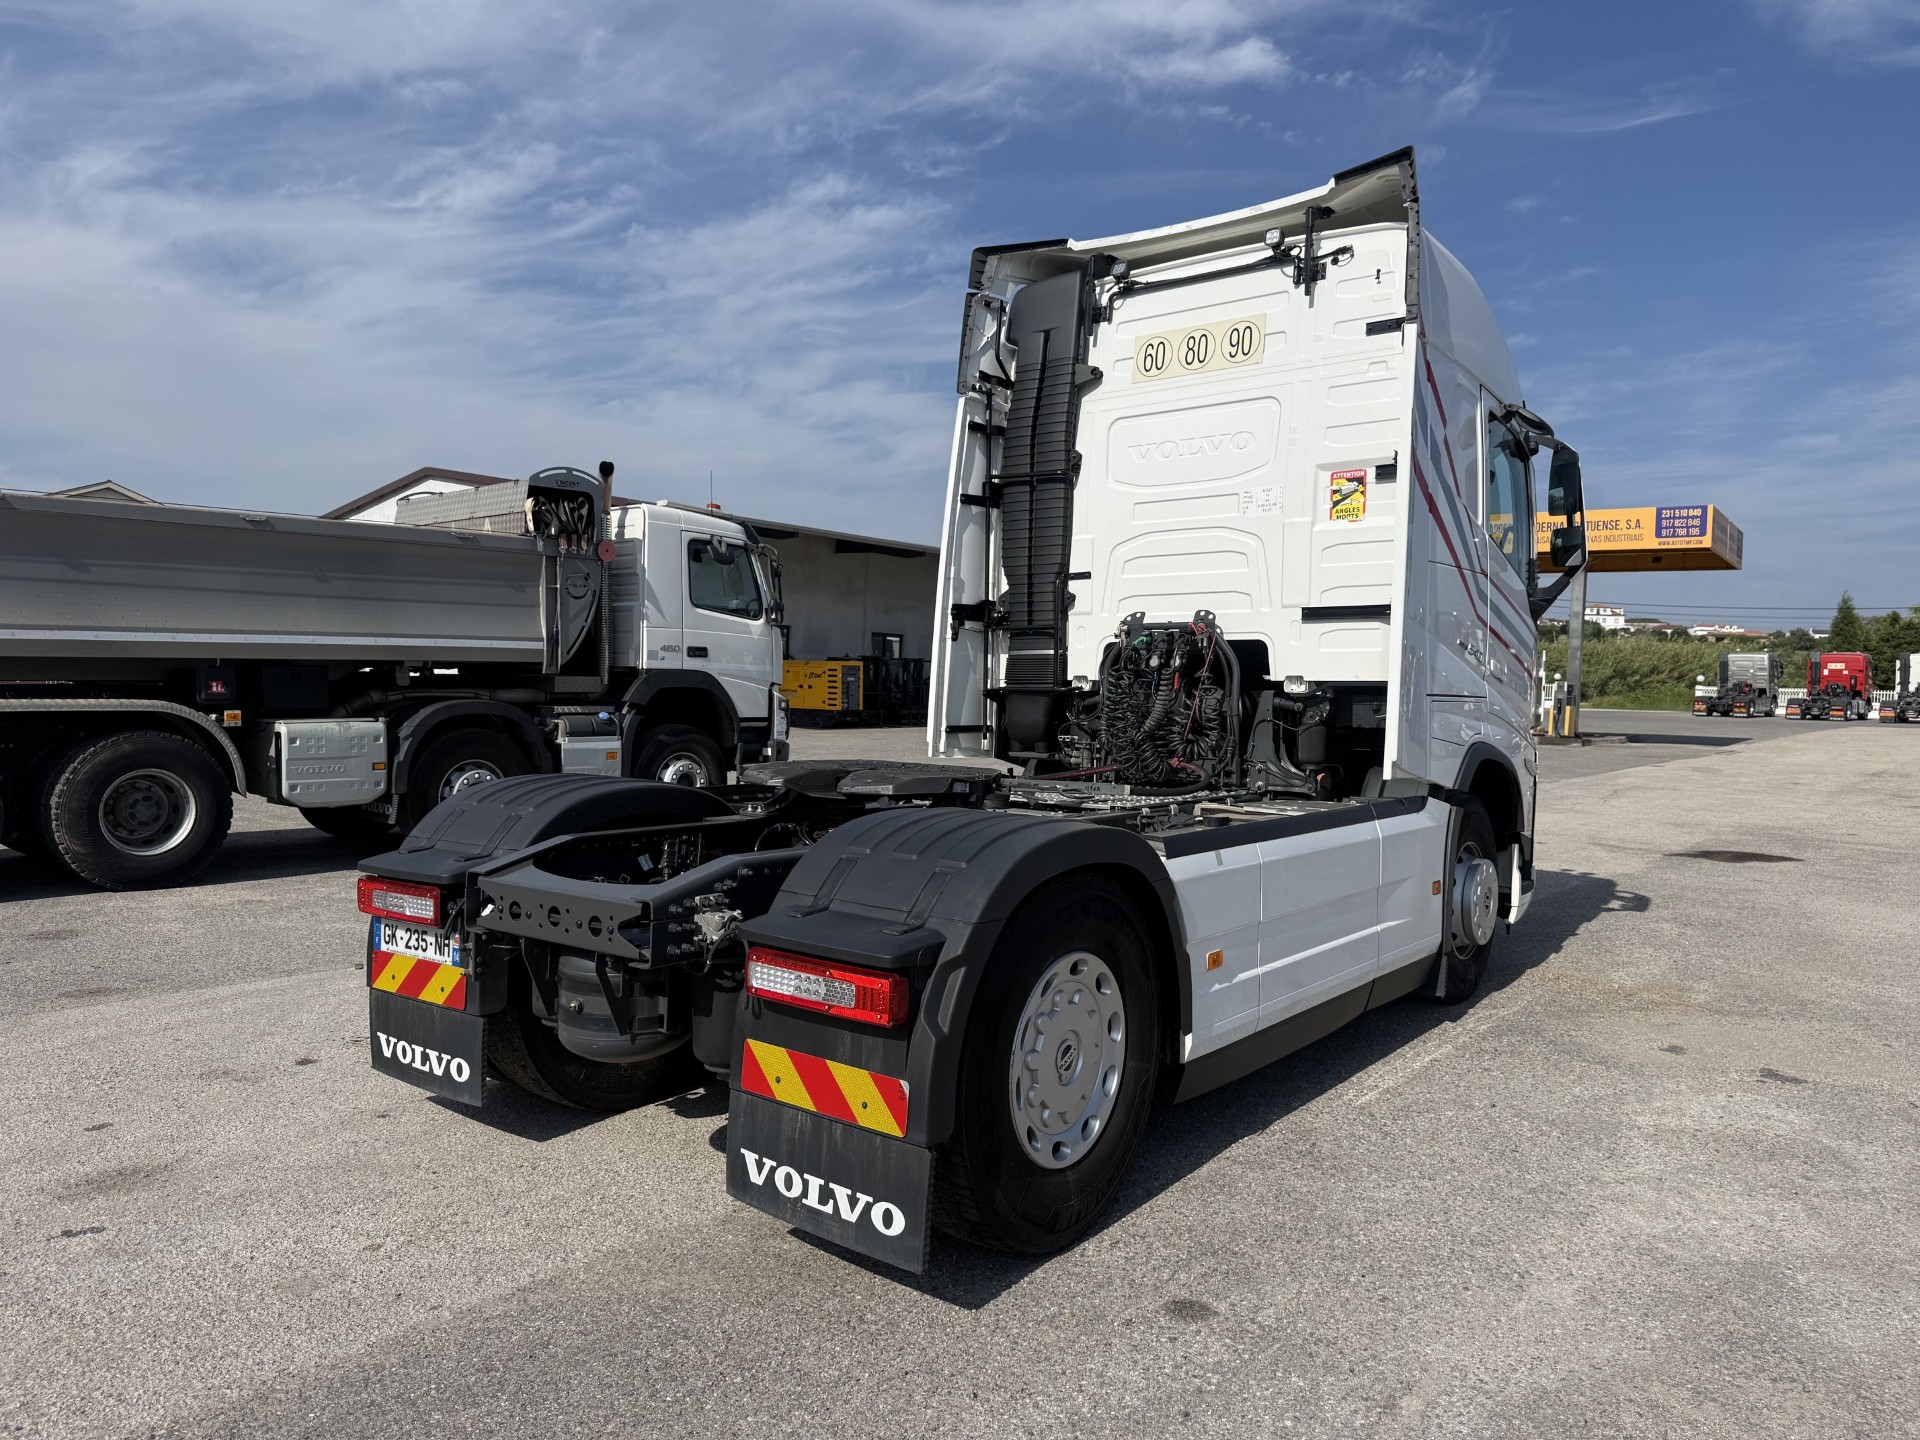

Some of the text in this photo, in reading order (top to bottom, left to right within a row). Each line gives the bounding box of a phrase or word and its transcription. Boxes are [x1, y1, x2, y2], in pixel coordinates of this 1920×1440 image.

[1143, 325, 1253, 373] 60 80 90
[1128, 430, 1256, 463] VOLVO
[1333, 470, 1365, 479] ATTENTION
[1335, 507, 1361, 515] ANGLES
[1661, 510, 1674, 518] 231
[1675, 509, 1688, 517] 510
[1661, 519, 1674, 527] 917
[1675, 518, 1687, 527] 822
[1661, 527, 1700, 537] 917 768 195
[1603, 533, 1644, 543] INDUSTRIAIS
[289, 764, 346, 774] VOLVO
[383, 923, 451, 958] GK-235-NH
[376, 1031, 471, 1083] VOLVO
[740, 1147, 906, 1237] VOLVO
